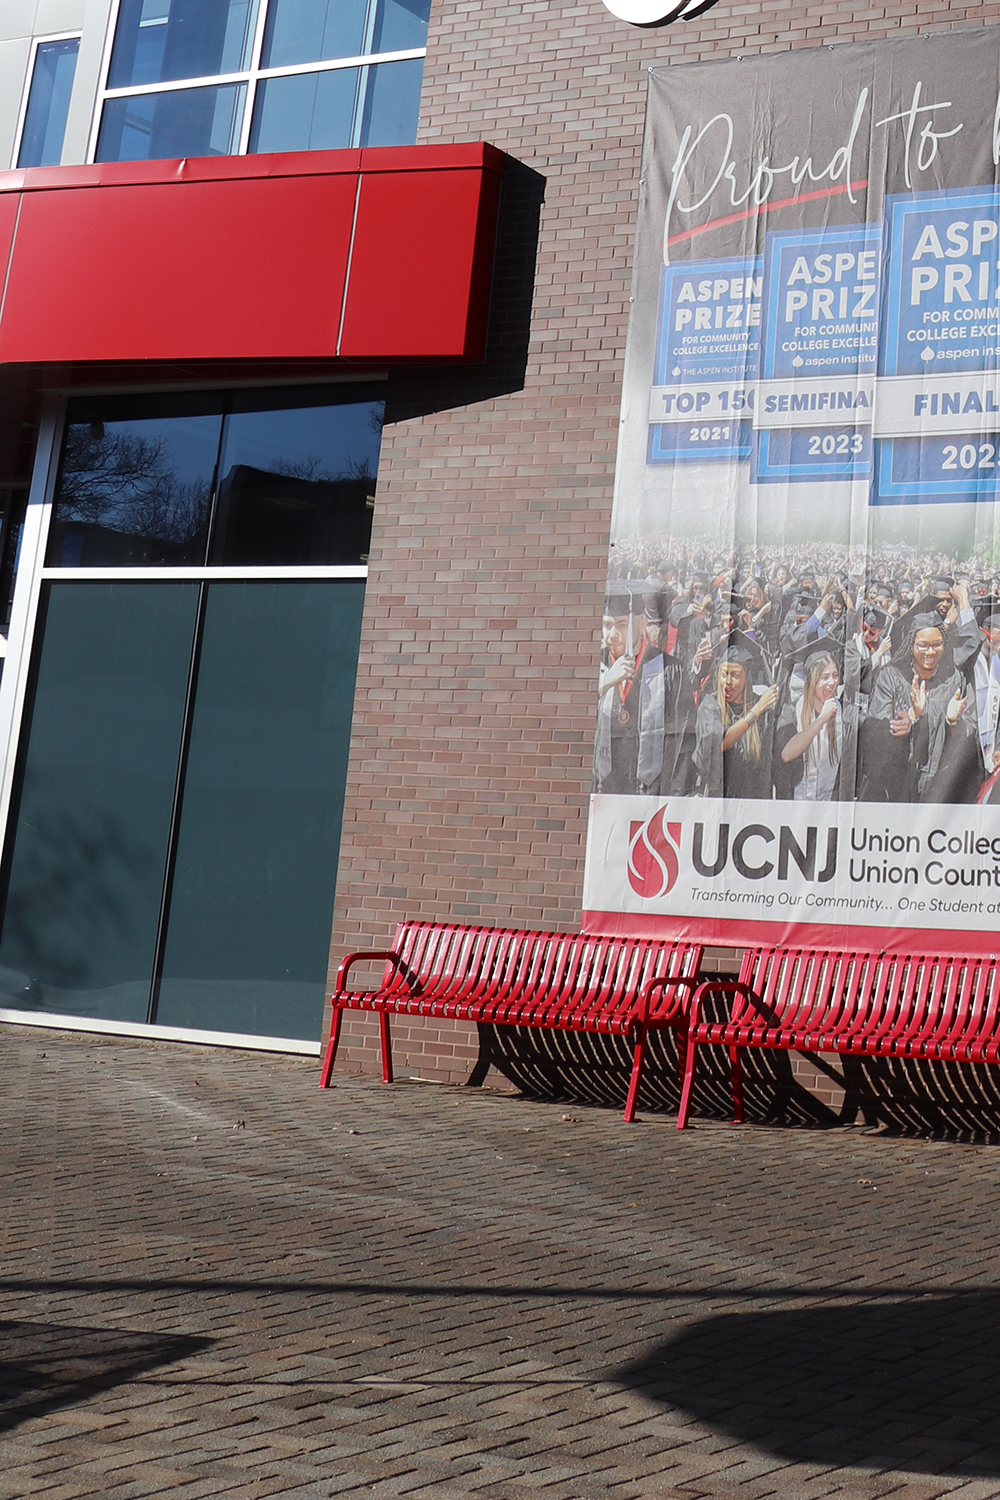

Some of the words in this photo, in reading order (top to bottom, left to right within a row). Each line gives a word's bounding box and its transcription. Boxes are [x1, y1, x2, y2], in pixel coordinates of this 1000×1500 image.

[662, 87, 869, 267] Proud
[876, 81, 963, 189] to
[787, 250, 881, 286] ASPE
[677, 277, 763, 303] ASPEN
[785, 285, 876, 322] PRIZ
[675, 303, 761, 331] PRIZE
[923, 311, 950, 324] FOR
[682, 335, 698, 344] FOR
[700, 332, 751, 343] COMMUNITY
[794, 327, 816, 337] FOR
[906, 326, 967, 342] COLLEGE
[673, 345, 707, 355] COLLEGE
[709, 343, 758, 353] EXCELLENCE
[782, 340, 829, 352] COLLEGE
[832, 336, 877, 349] EXCELLE
[805, 357, 839, 367] aspen
[841, 353, 876, 364] institu
[937, 350, 980, 361] aspen
[697, 366, 720, 375] ASPEN
[722, 365, 757, 373] INSTITUTE
[662, 392, 711, 414] TOP
[690, 426, 730, 441] 2021
[808, 434, 863, 455] 2023
[850, 827, 920, 853] Union
[692, 822, 838, 882] UCNJ
[849, 859, 919, 884] Union
[691, 887, 775, 907] Transforming
[778, 892, 802, 906] Our
[805, 893, 893, 912] Community...
[898, 897, 926, 911] One
[929, 898, 984, 914] Student
[987, 901, 1000, 914] at
